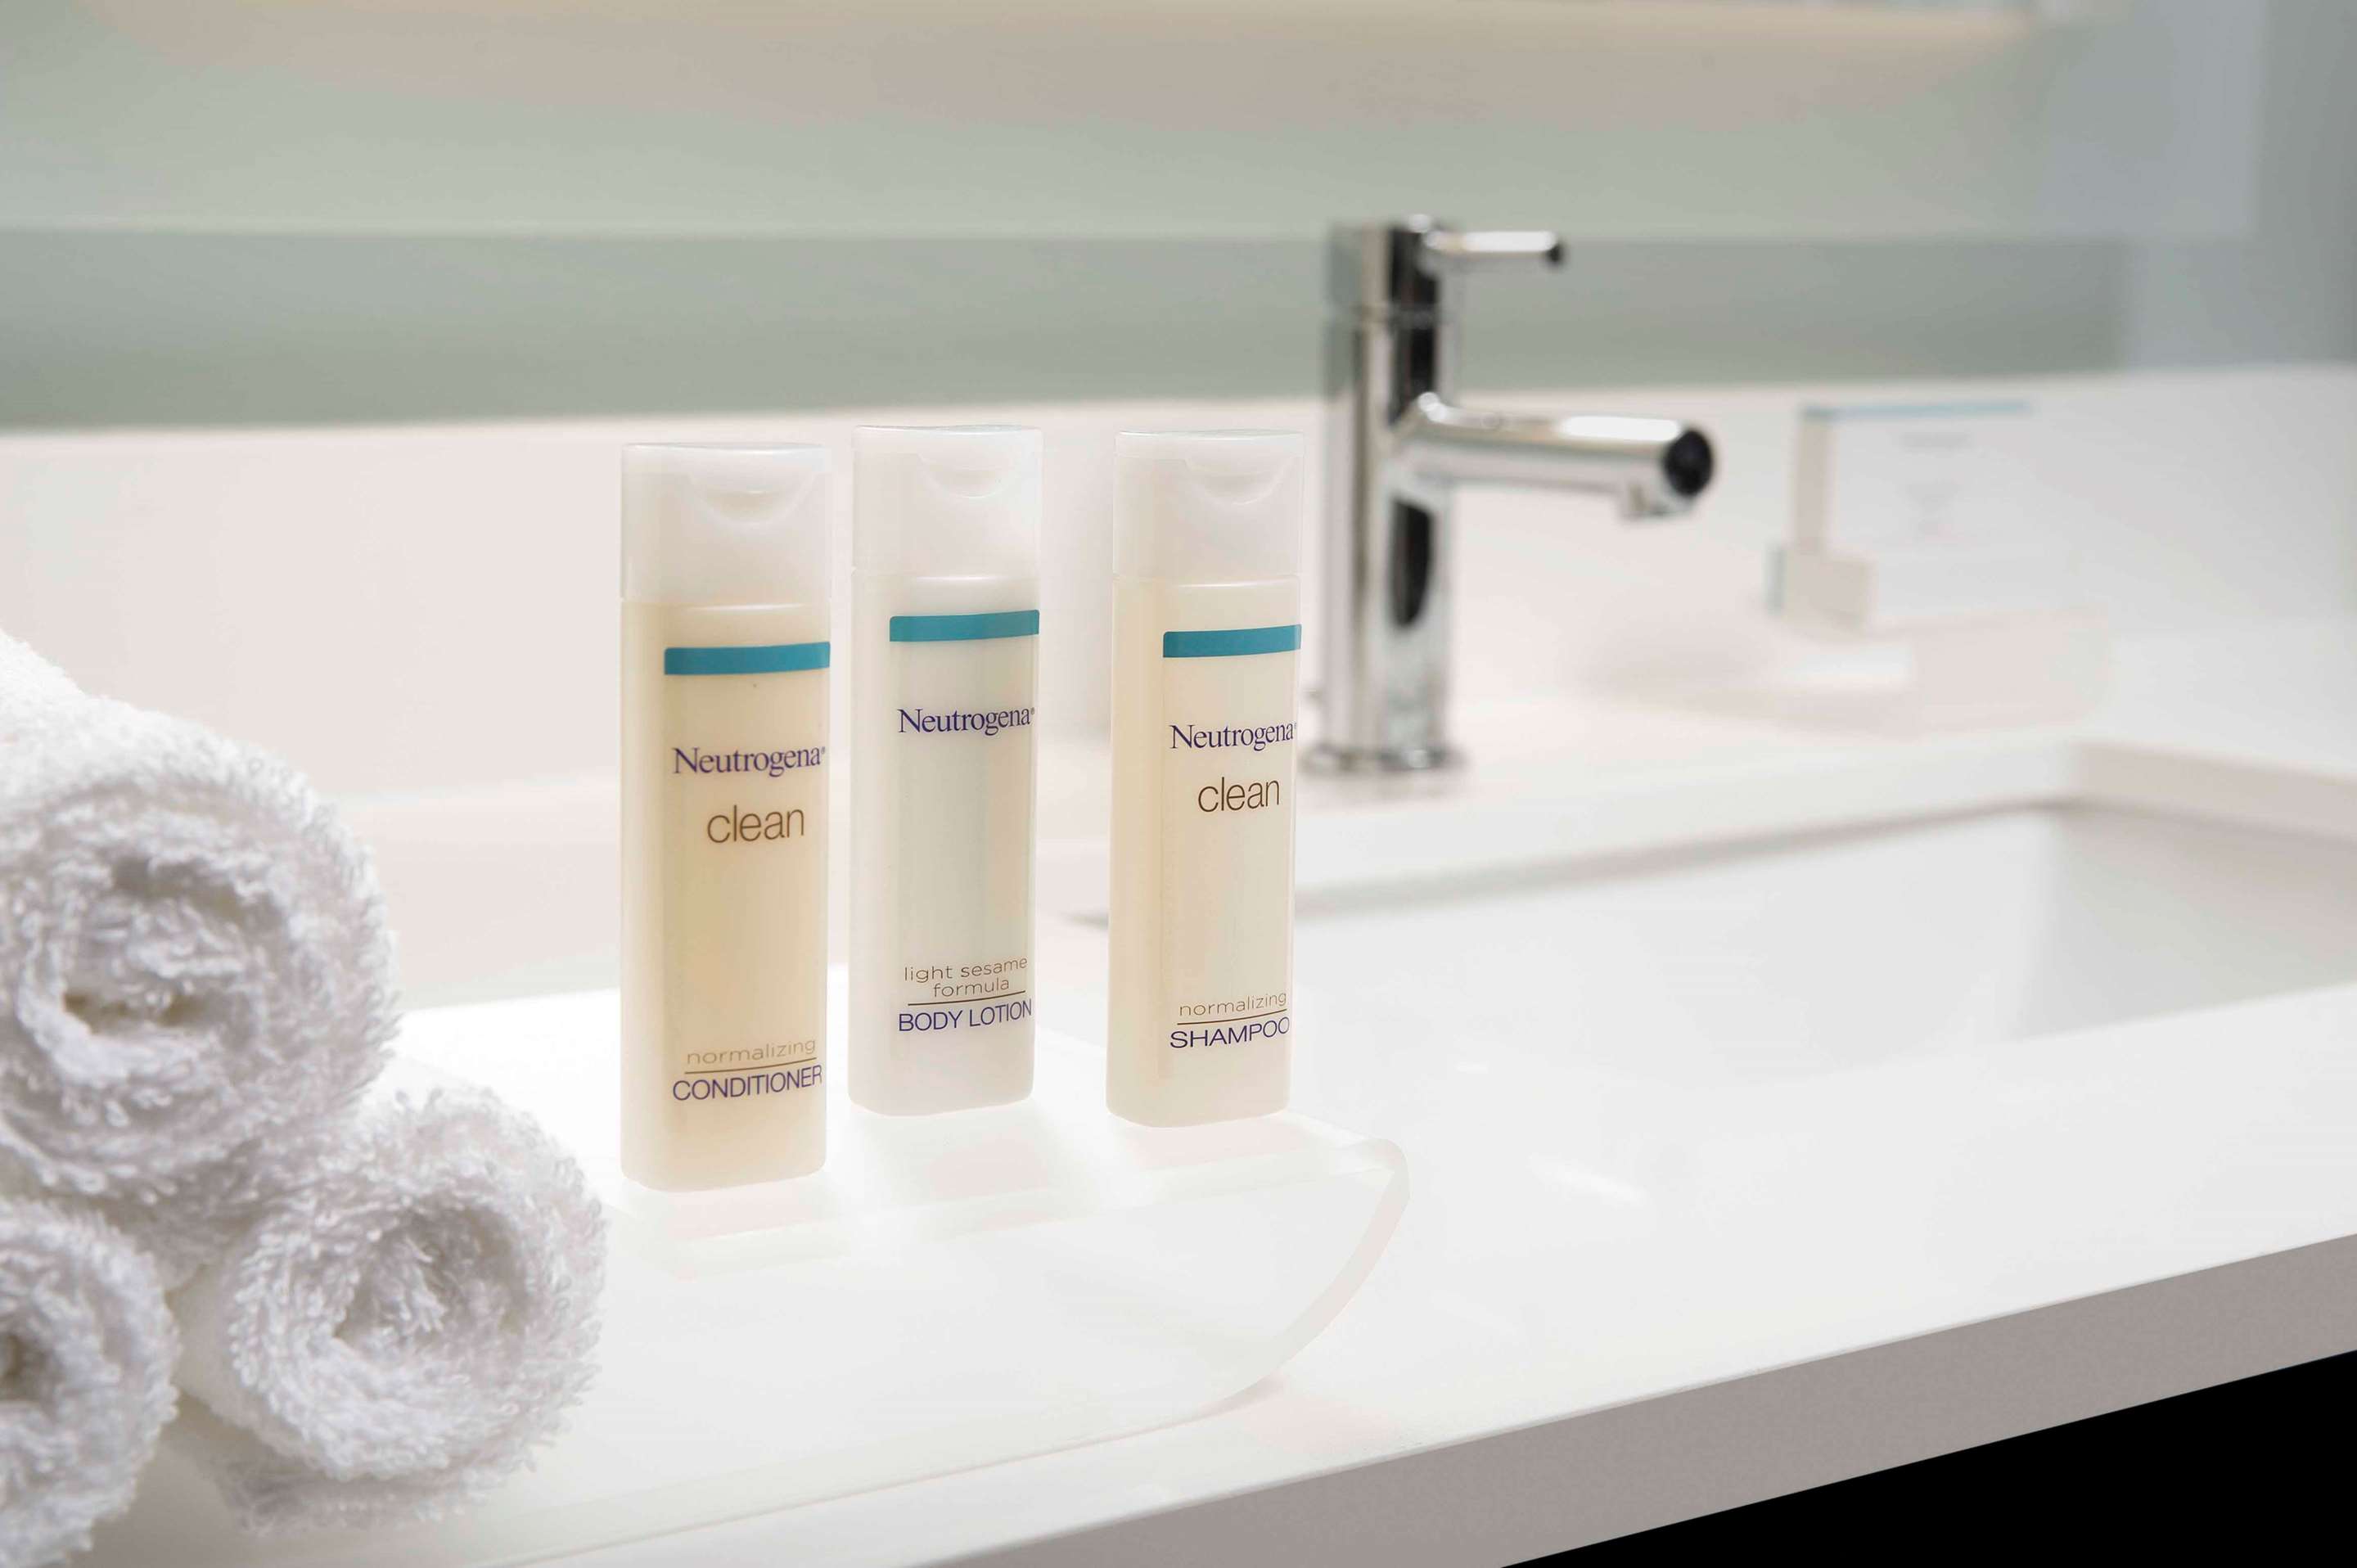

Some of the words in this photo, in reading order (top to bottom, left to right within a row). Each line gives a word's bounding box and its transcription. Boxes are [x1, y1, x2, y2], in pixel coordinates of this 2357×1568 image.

[1197, 776, 1280, 813] clean
[707, 804, 805, 844] clean
[904, 966, 953, 983] light
[960, 957, 1028, 977] sesame
[933, 977, 1010, 997] formula
[899, 1009, 963, 1031] BODY
[969, 998, 1032, 1027] LOTION
[1179, 992, 1287, 1016] normalizing
[1169, 1016, 1291, 1048] SHAMPOO
[687, 1040, 817, 1065] normalizing
[673, 1064, 822, 1101] CONDITIONER
